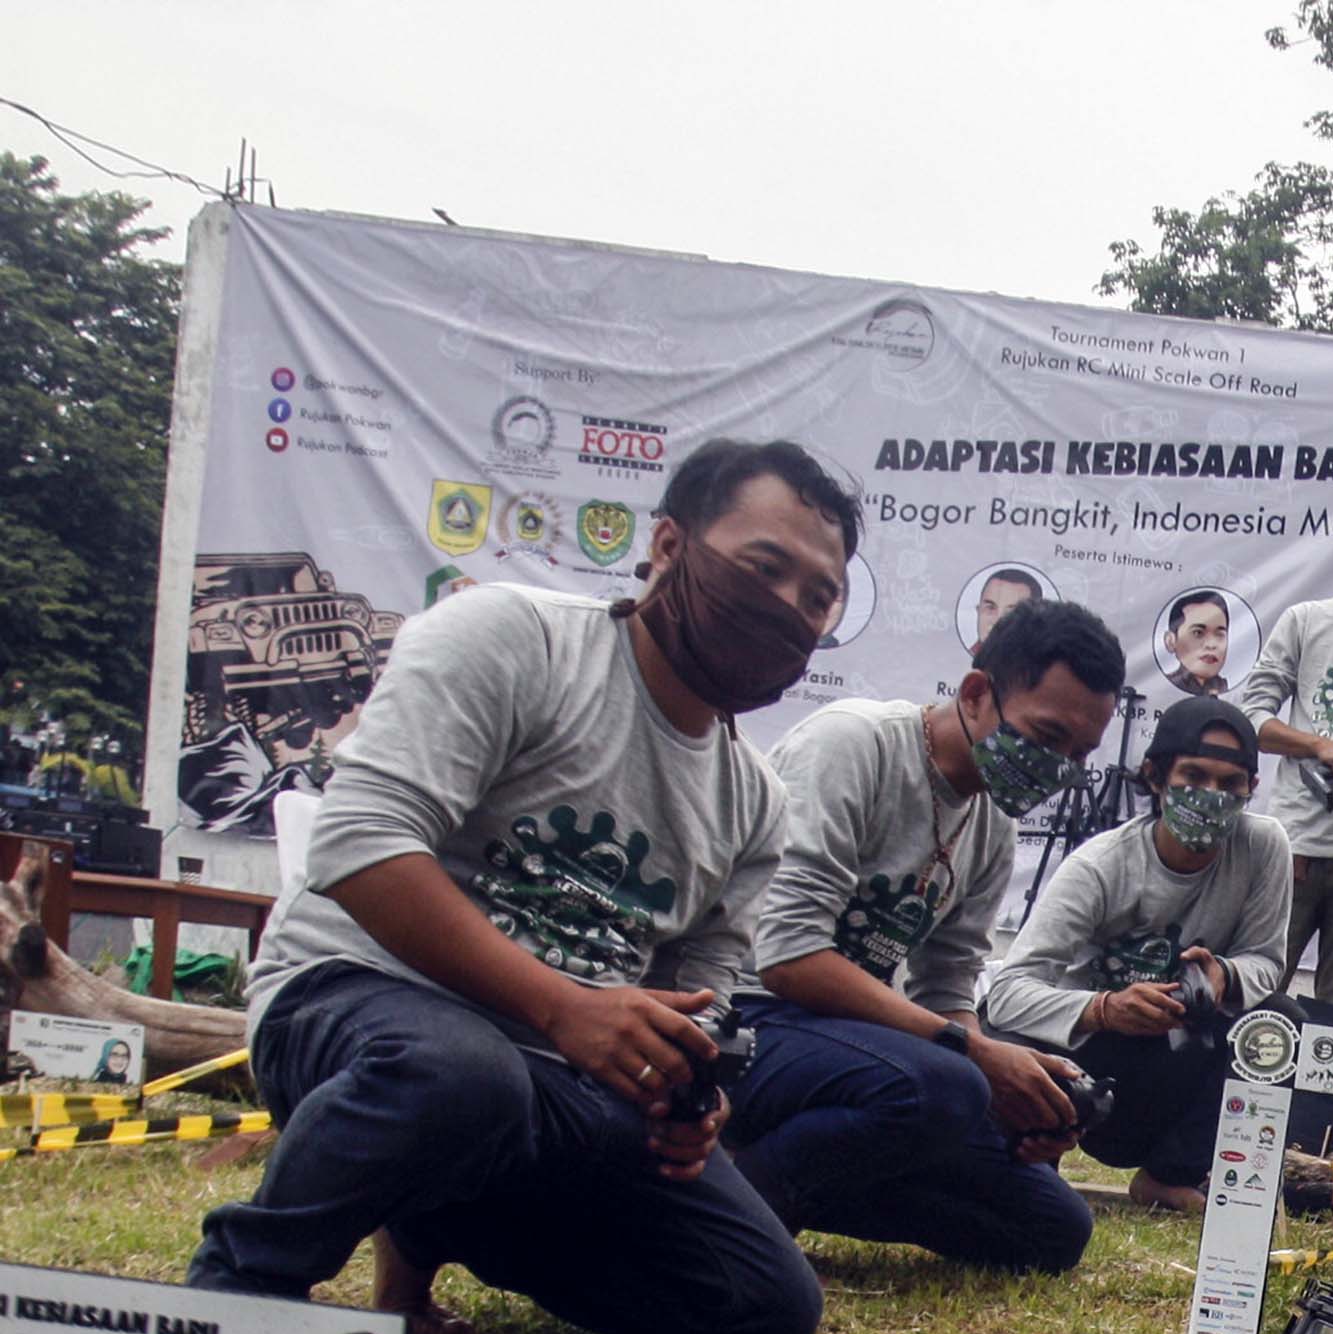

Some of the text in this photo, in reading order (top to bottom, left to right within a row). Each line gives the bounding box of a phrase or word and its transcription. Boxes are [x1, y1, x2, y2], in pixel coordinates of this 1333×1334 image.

[1051, 324, 1246, 364] Tournament Pokwan 1
[514, 361, 595, 386] Support By
[1001, 347, 1298, 399] Rujukan RC Mini Scale Off Road
[581, 427, 664, 461] FOTO
[875, 439, 1055, 474] ADAPTASI
[1065, 440, 1284, 480] KEBIASAAN
[989, 497, 1119, 536] Bangkit,
[1132, 502, 1286, 536] Indonesia
[1053, 543, 1106, 564] Peserta
[1112, 549, 1173, 572] Istimewa
[15, 1295, 150, 1334] KEBIASAAN
